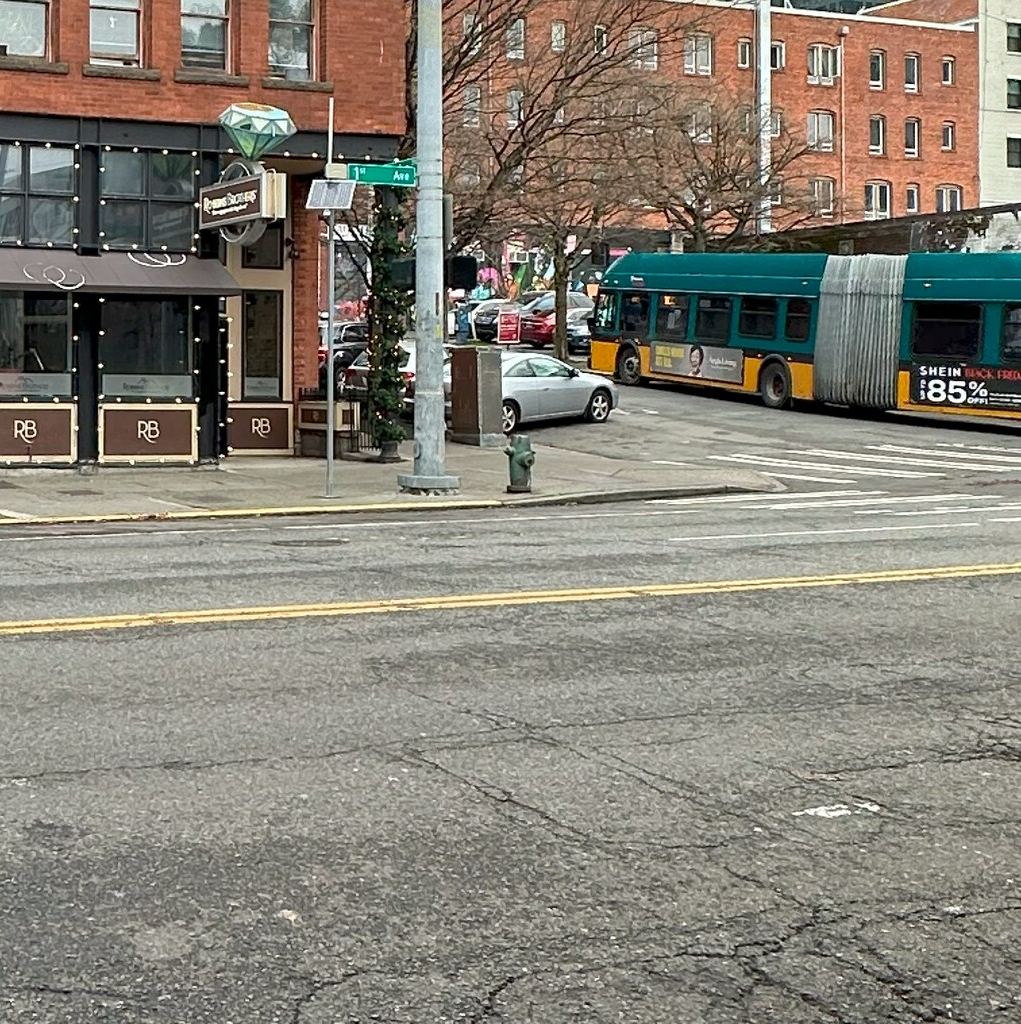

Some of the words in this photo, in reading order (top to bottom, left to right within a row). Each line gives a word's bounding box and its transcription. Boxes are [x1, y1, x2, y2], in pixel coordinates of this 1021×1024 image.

[393, 170, 410, 181] Ave
[919, 366, 962, 377] SHEIN
[927, 379, 989, 404] 85%
[13, 419, 37, 443] RB
[137, 420, 160, 444] RB
[251, 417, 271, 439] RB
